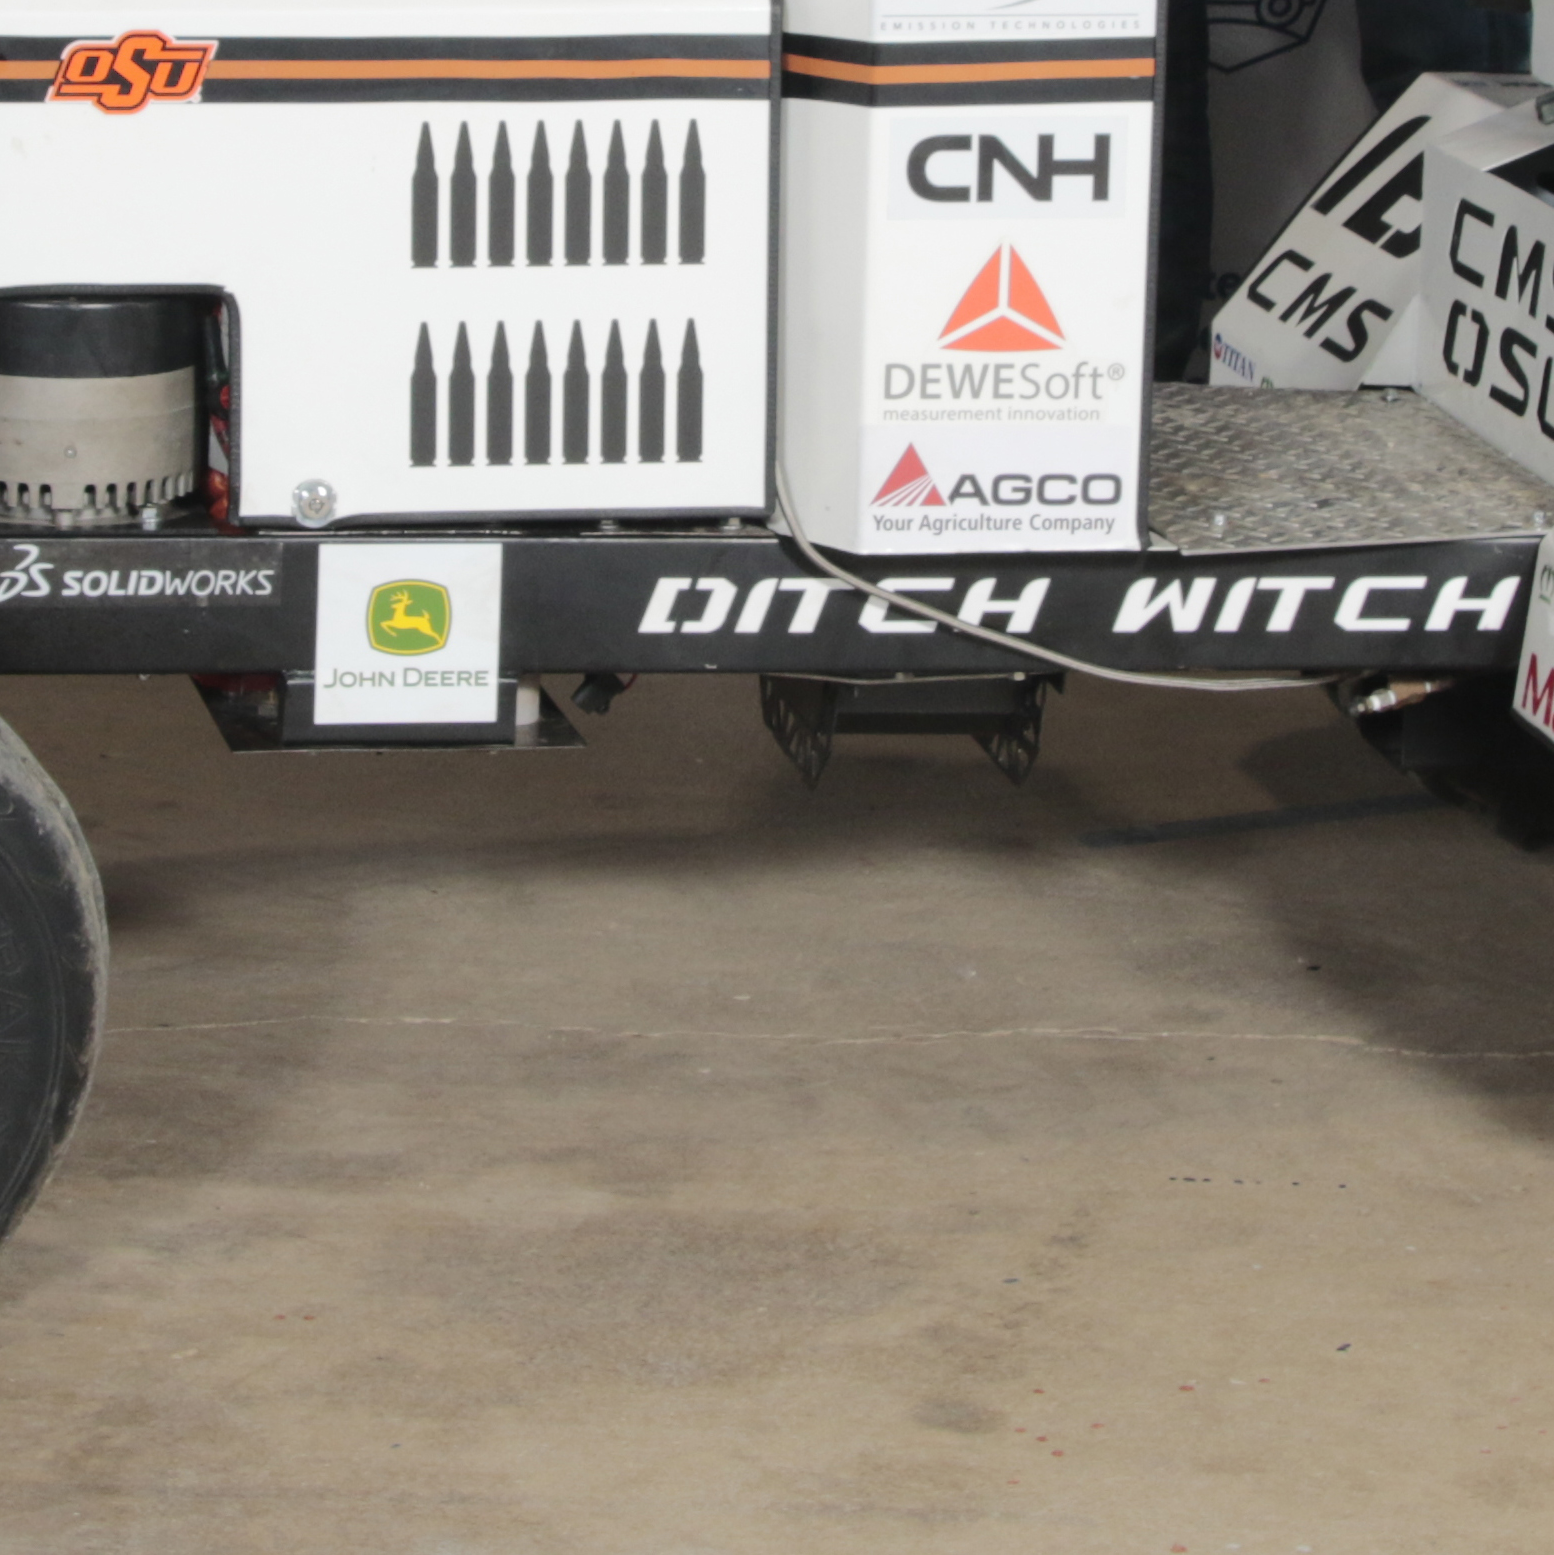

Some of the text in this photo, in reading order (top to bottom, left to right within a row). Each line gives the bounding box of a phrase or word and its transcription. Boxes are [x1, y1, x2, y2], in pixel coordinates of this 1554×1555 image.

[880, 19, 1141, 32] EMISSION TECHNOLOGIES
[50, 31, 217, 114] OSU
[906, 133, 1111, 203] CNH
[1246, 250, 1393, 363] CMS
[1221, 342, 1256, 382] TITAN
[883, 406, 1101, 422] measurement innovation
[948, 473, 1123, 507] AGCO
[873, 513, 1116, 536] Your Agriculture Company
[60, 568, 276, 599] SOLIDWORKS
[640, 576, 1521, 634] DITCH WITCH
[324, 666, 491, 692] JOHN DEERE
